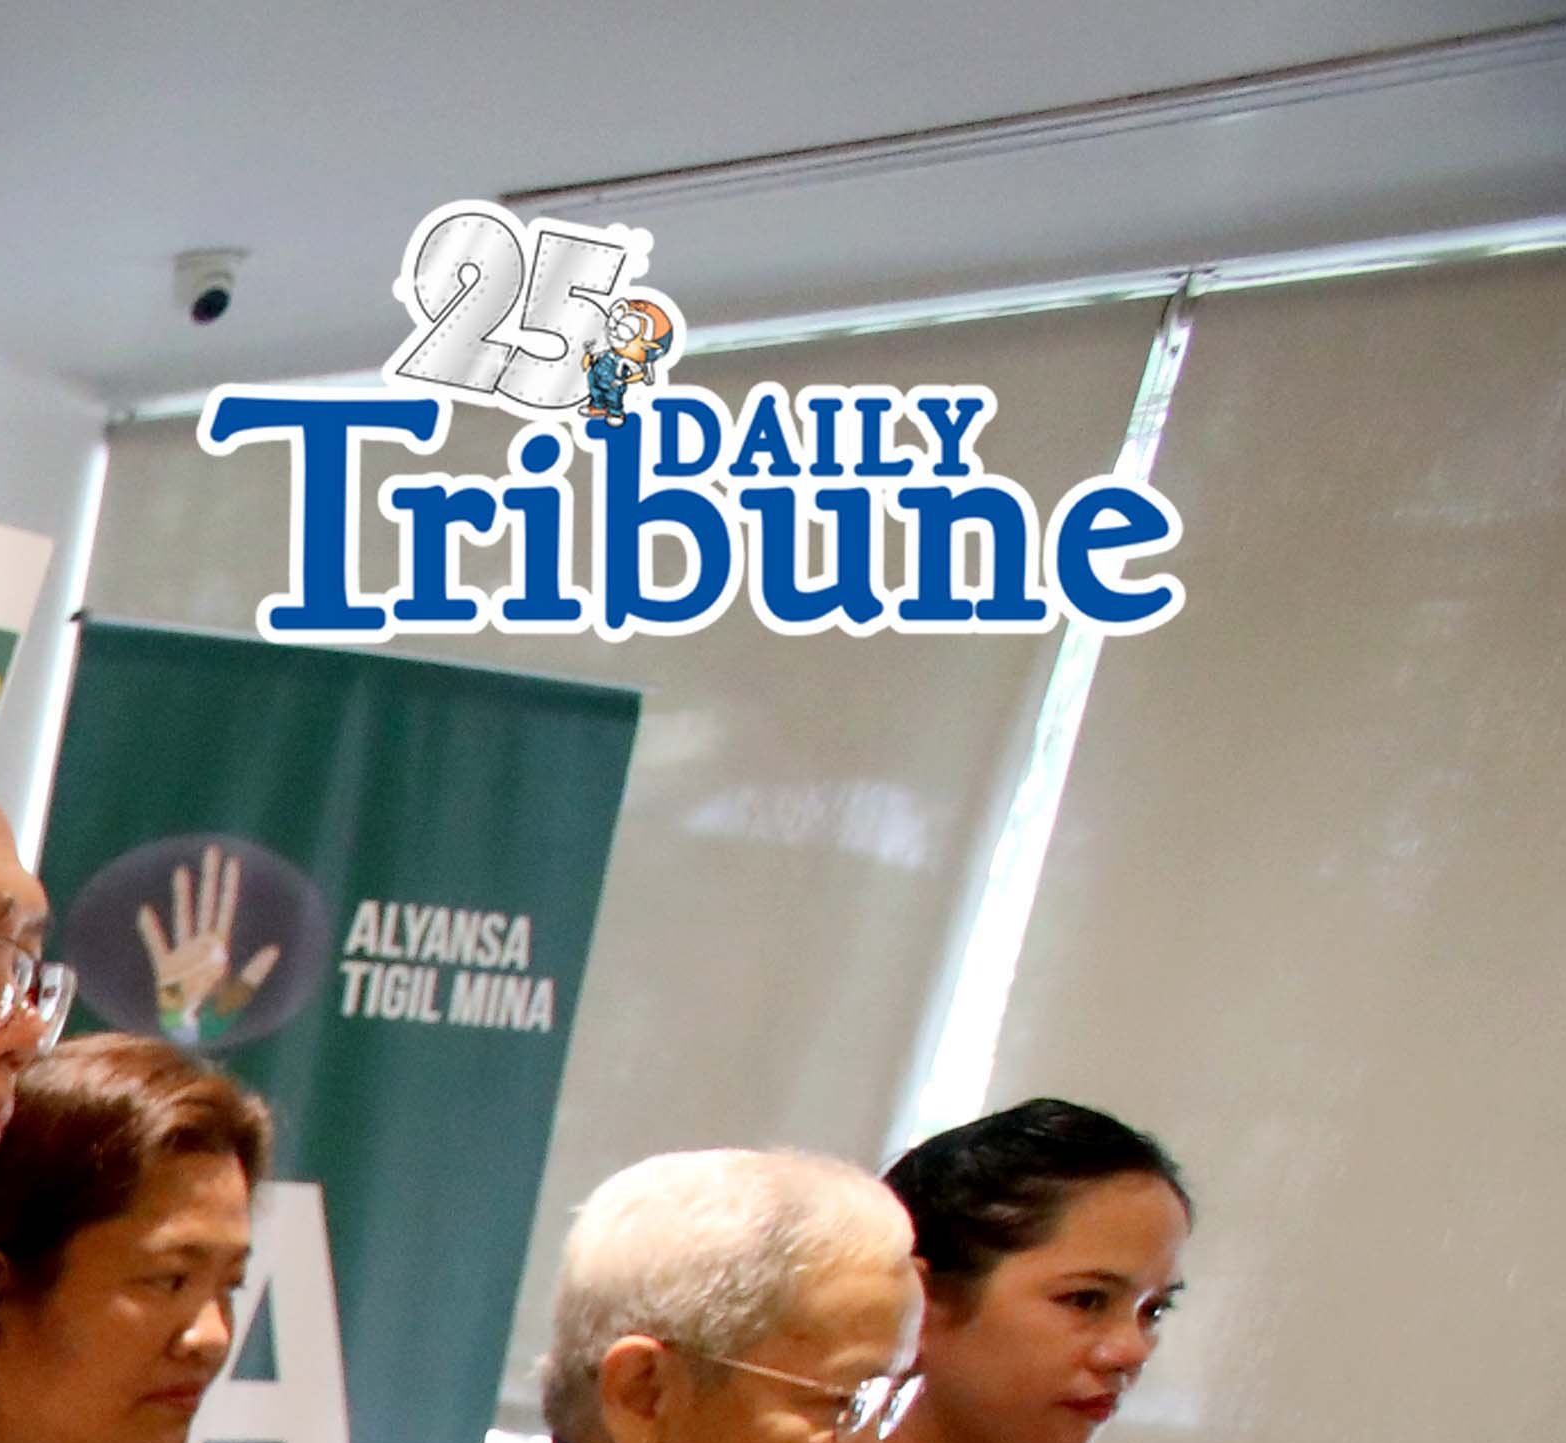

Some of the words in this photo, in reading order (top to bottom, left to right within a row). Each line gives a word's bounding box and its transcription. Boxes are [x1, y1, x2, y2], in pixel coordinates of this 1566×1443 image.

[345, 898, 531, 968] ALYANSA
[341, 961, 442, 1023] TIGIL
[448, 973, 554, 1033] MINA
